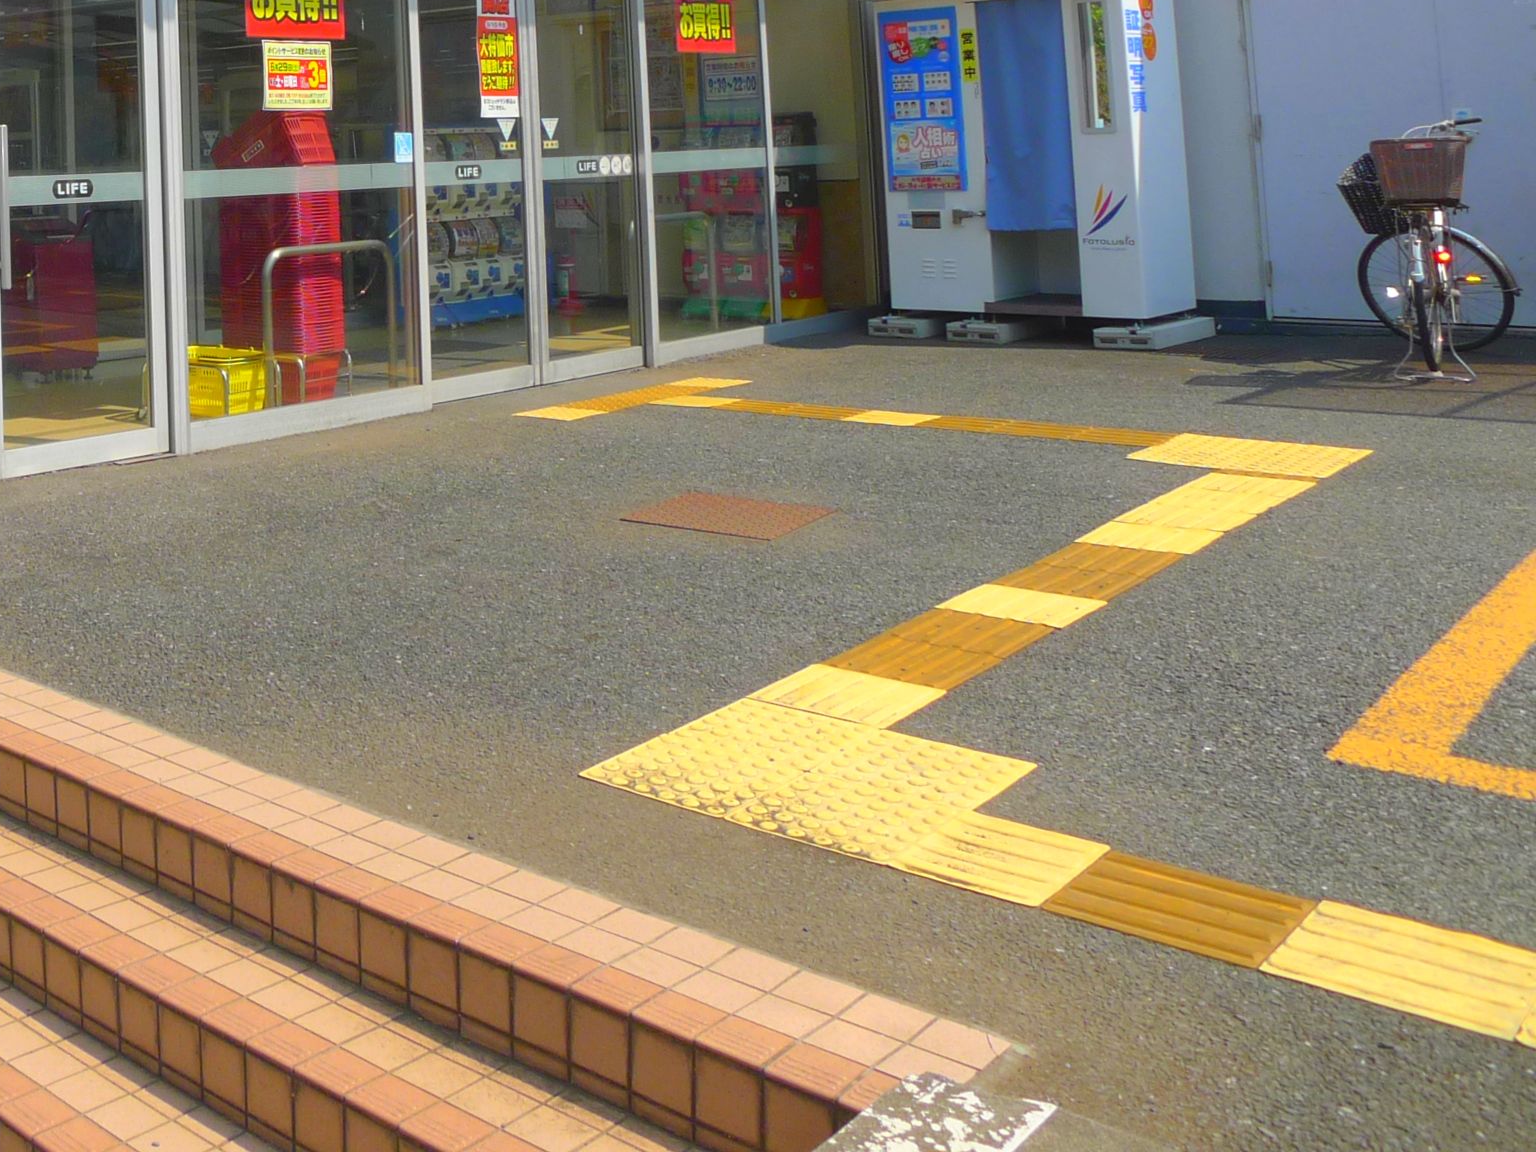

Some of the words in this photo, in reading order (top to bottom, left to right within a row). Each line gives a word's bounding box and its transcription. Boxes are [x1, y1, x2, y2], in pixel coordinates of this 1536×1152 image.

[960, 32, 976, 79] 営業中
[1125, 9, 1148, 112] 証明写真
[457, 166, 480, 179] LIFE
[578, 161, 598, 172] LIFE
[56, 181, 89, 195] LIFE
